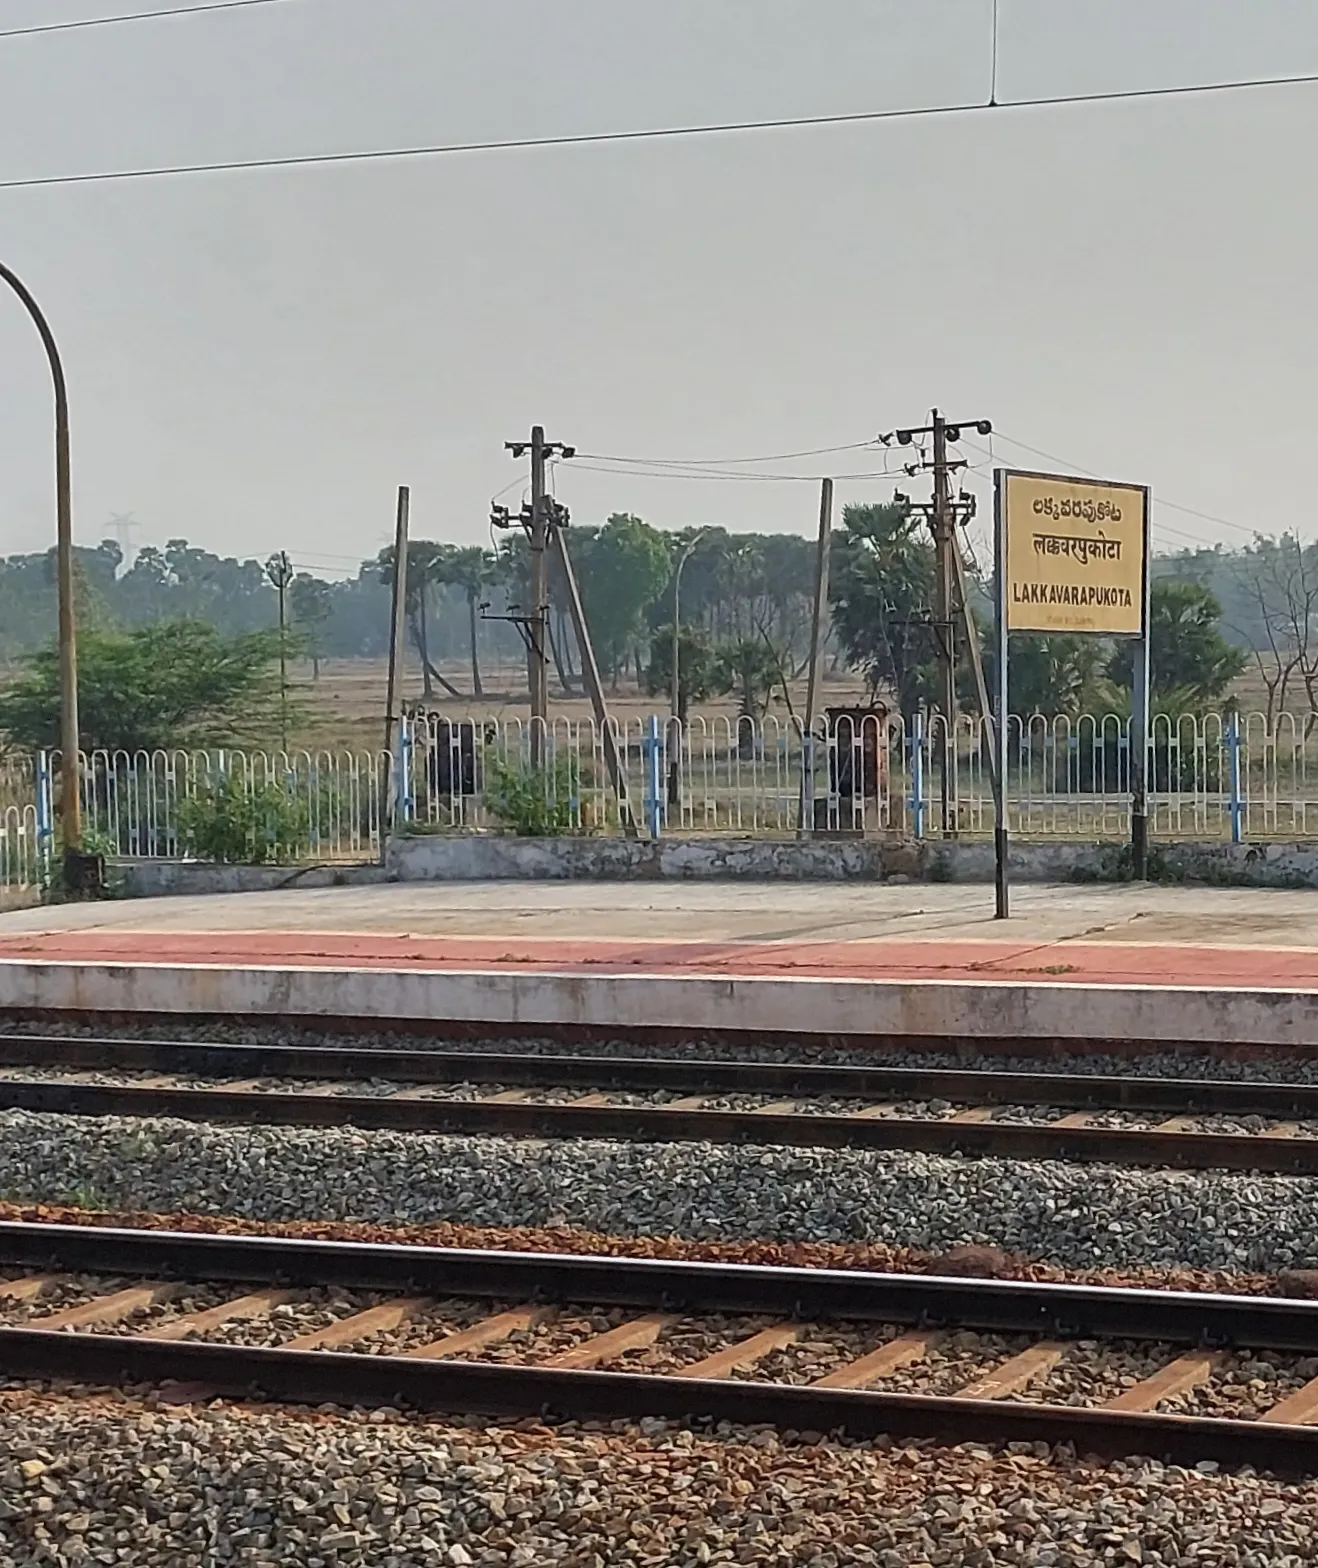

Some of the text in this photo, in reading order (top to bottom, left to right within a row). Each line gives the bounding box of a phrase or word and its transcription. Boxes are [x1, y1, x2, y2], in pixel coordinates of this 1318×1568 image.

[1033, 497, 1121, 522] లక్కవరపుకోట
[1033, 530, 1121, 564] लक्कवरपुकोटा
[1014, 583, 1132, 607] LAKKAVARAPUKOTA
